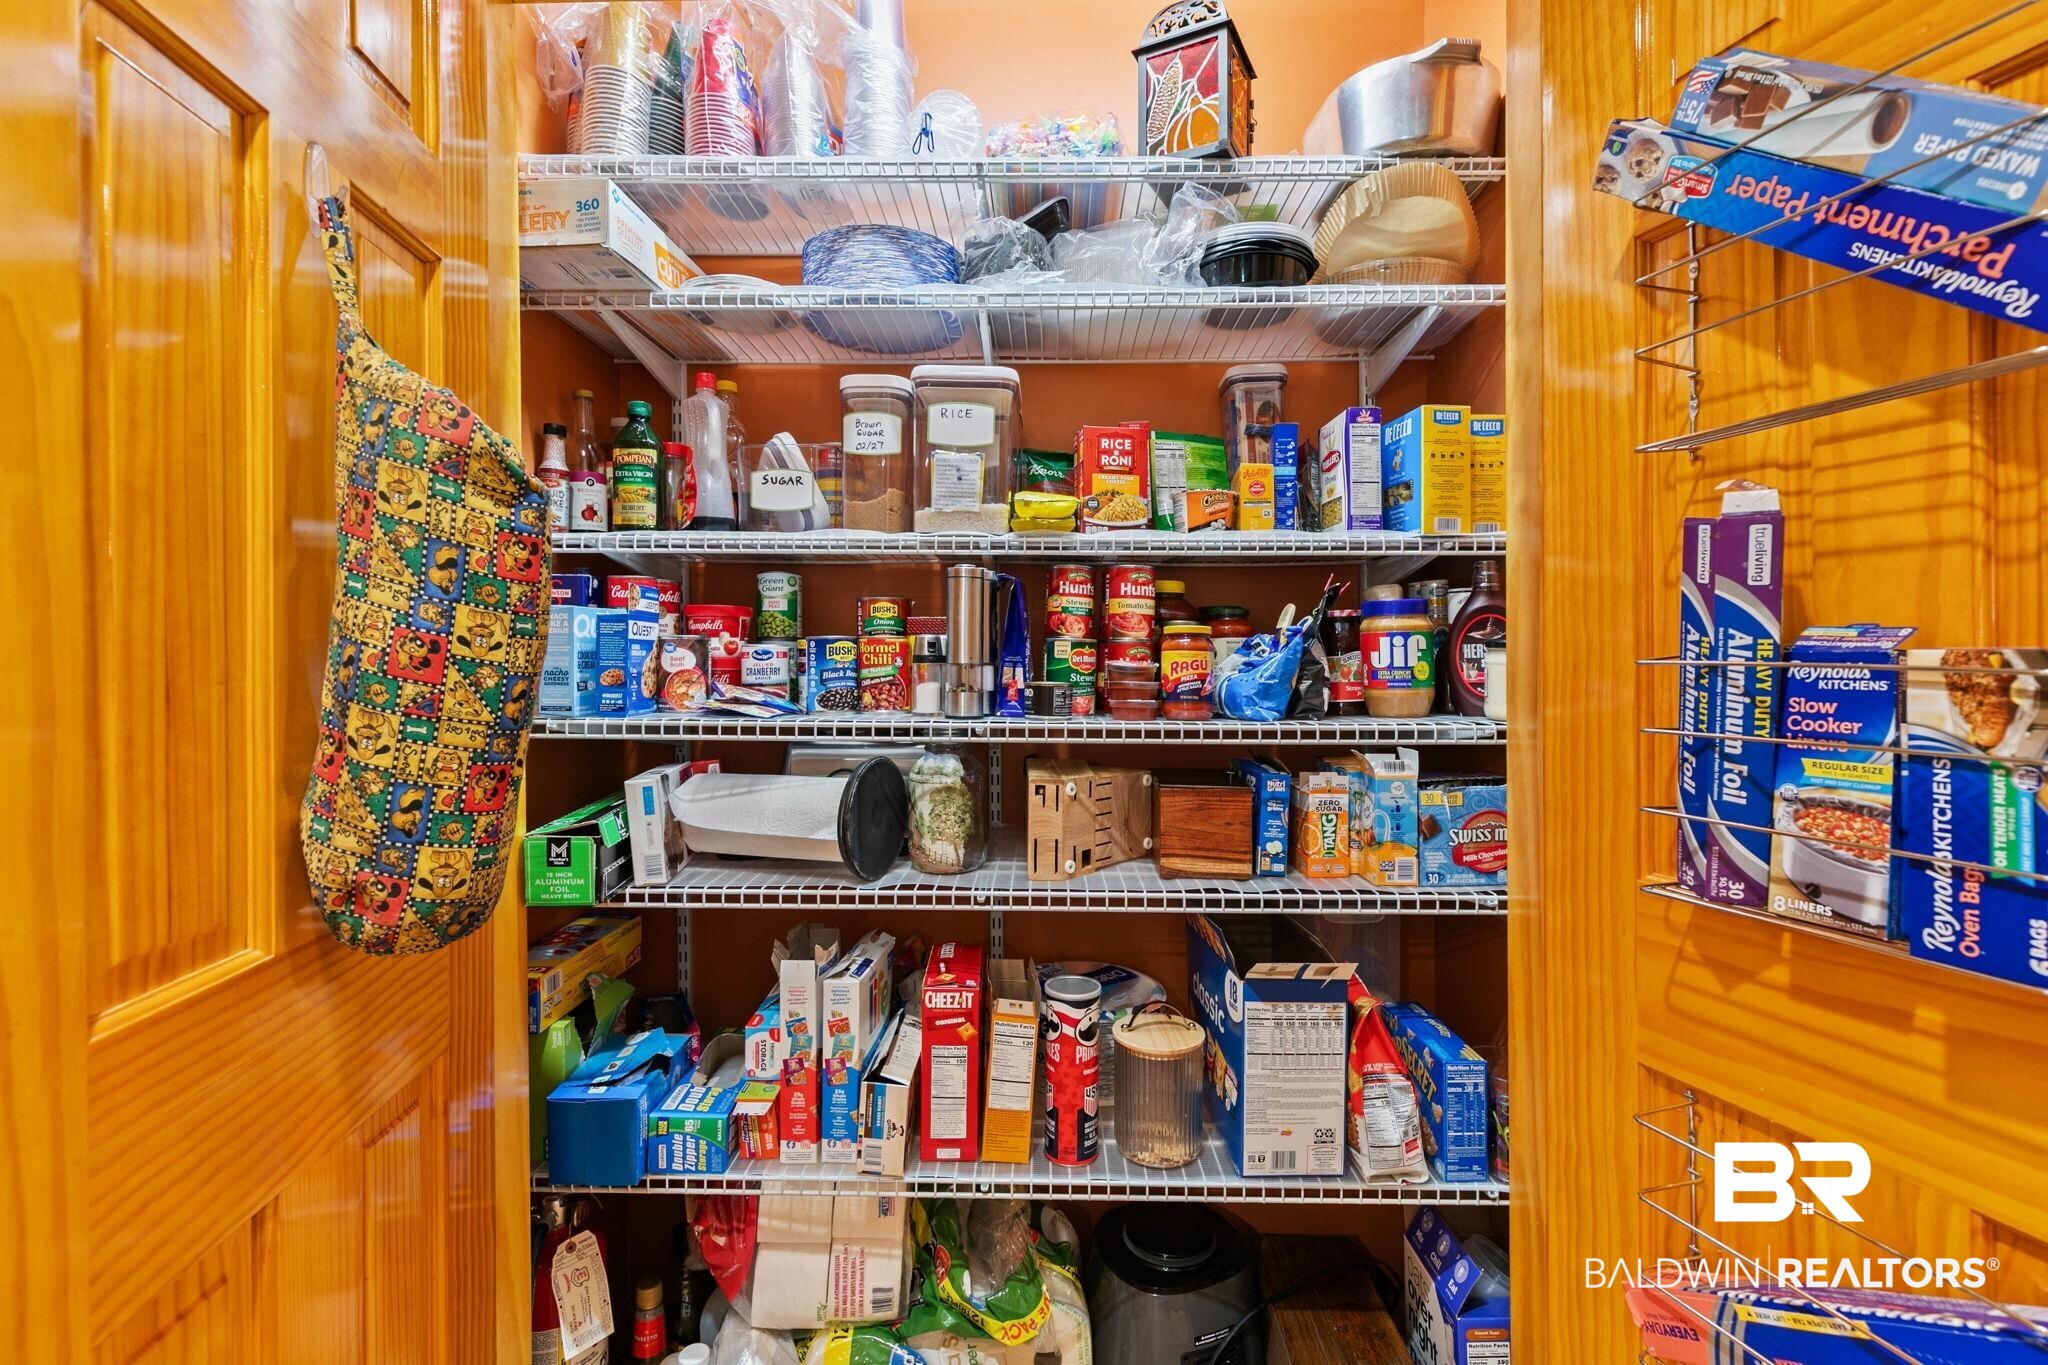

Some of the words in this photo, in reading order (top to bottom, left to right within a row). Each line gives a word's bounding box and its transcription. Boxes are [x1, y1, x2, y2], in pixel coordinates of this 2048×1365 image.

[1971, 146, 2041, 178] WAXED
[576, 198, 599, 212] 360
[1725, 174, 1801, 222] Paper
[940, 408, 974, 420] RICE
[855, 418, 882, 429] Brown
[856, 441, 884, 451] 02/27
[1101, 438, 1132, 451] RICE
[617, 453, 652, 465] POMPEIAN
[633, 470, 653, 478] VIRGIN
[1028, 464, 1065, 479] Knorr
[761, 475, 804, 487] SUGAR
[1751, 527, 1768, 583] trueliving
[759, 576, 784, 585] Green
[872, 605, 897, 615] BUSH'S
[689, 620, 723, 631] Campbell's
[863, 653, 892, 665] Chili
[1371, 635, 1426, 668] Jif
[544, 668, 569, 676] nacho
[746, 667, 780, 676] CRANBERRY
[823, 670, 844, 679] Black
[1171, 656, 1207, 677] RAGÚ
[1818, 679, 1888, 691] KITCHENS
[1699, 691, 1708, 732] DUTY
[1788, 697, 1838, 715] Slow
[1754, 696, 1771, 738] DUTY
[1787, 715, 1863, 735] Cooker
[1684, 751, 1696, 795] Foil
[1812, 761, 1859, 773] REGULAR
[1862, 765, 1884, 776] SIZE
[1722, 761, 1748, 805] Foil
[1425, 793, 1434, 802] 30
[1322, 814, 1337, 850] TANG
[1993, 806, 2007, 848] TENDER
[1463, 854, 1477, 862] Milk
[1427, 874, 1438, 883] 30
[1728, 881, 1745, 900] 30
[1773, 895, 1786, 912] 8
[1787, 898, 1833, 917] LINERS
[1959, 903, 1984, 958] Oven
[2029, 919, 2047, 957] BAGS
[925, 991, 974, 1009] CHEEZ-IT
[1229, 979, 1238, 1004] 18
[1193, 971, 1225, 1034] classic
[935, 1017, 966, 1026] ORIGINAL
[685, 1120, 693, 1131] 65
[672, 1134, 683, 1171] Double
[685, 1135, 697, 1171] Zipper
[698, 1140, 707, 1171] Storage
[1644, 1320, 1699, 1342] EVERYDAY
